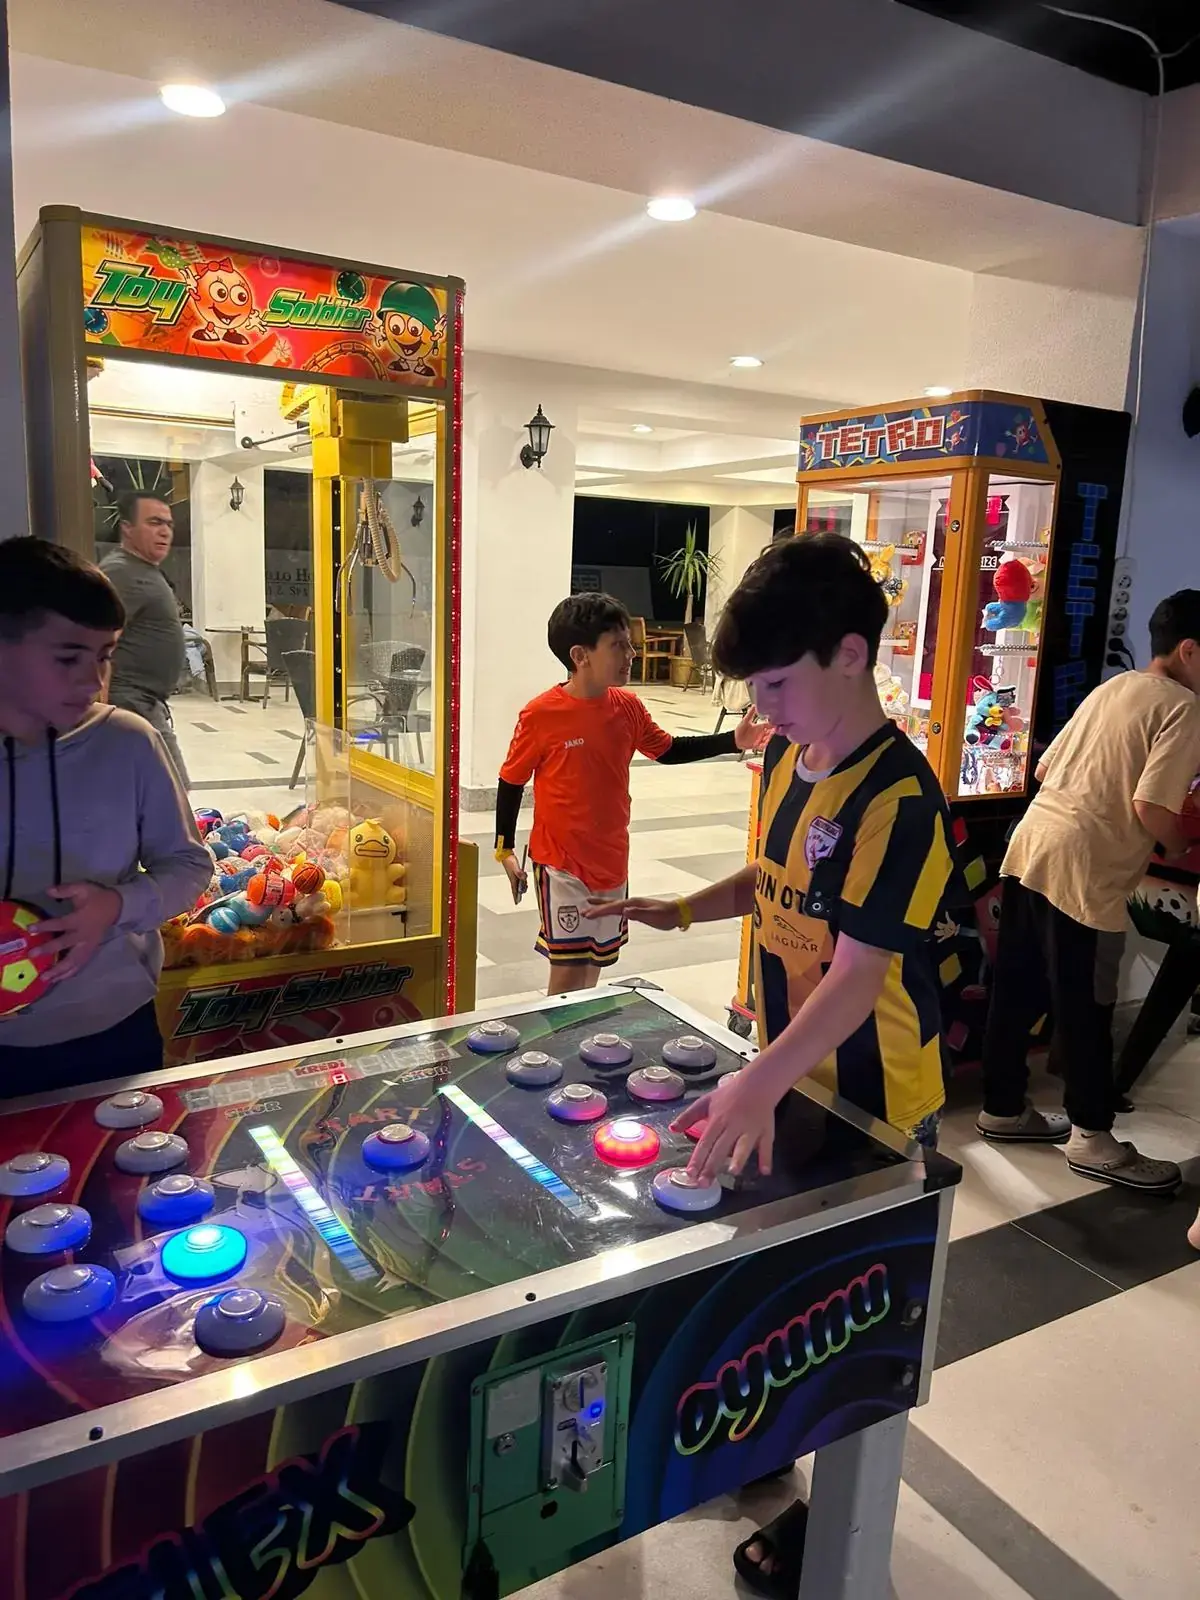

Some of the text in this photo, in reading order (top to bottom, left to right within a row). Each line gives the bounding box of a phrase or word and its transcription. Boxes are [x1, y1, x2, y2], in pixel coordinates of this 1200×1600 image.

[92, 259, 373, 332] Toy Soldier
[816, 416, 945, 460] TETRO
[1053, 482, 1108, 734] TETR
[564, 737, 585, 749] JAKO
[780, 884, 807, 914] OT
[770, 931, 818, 952] JAGUAR
[173, 960, 413, 1038] Toy Soldier
[673, 1262, 891, 1456] oyunu
